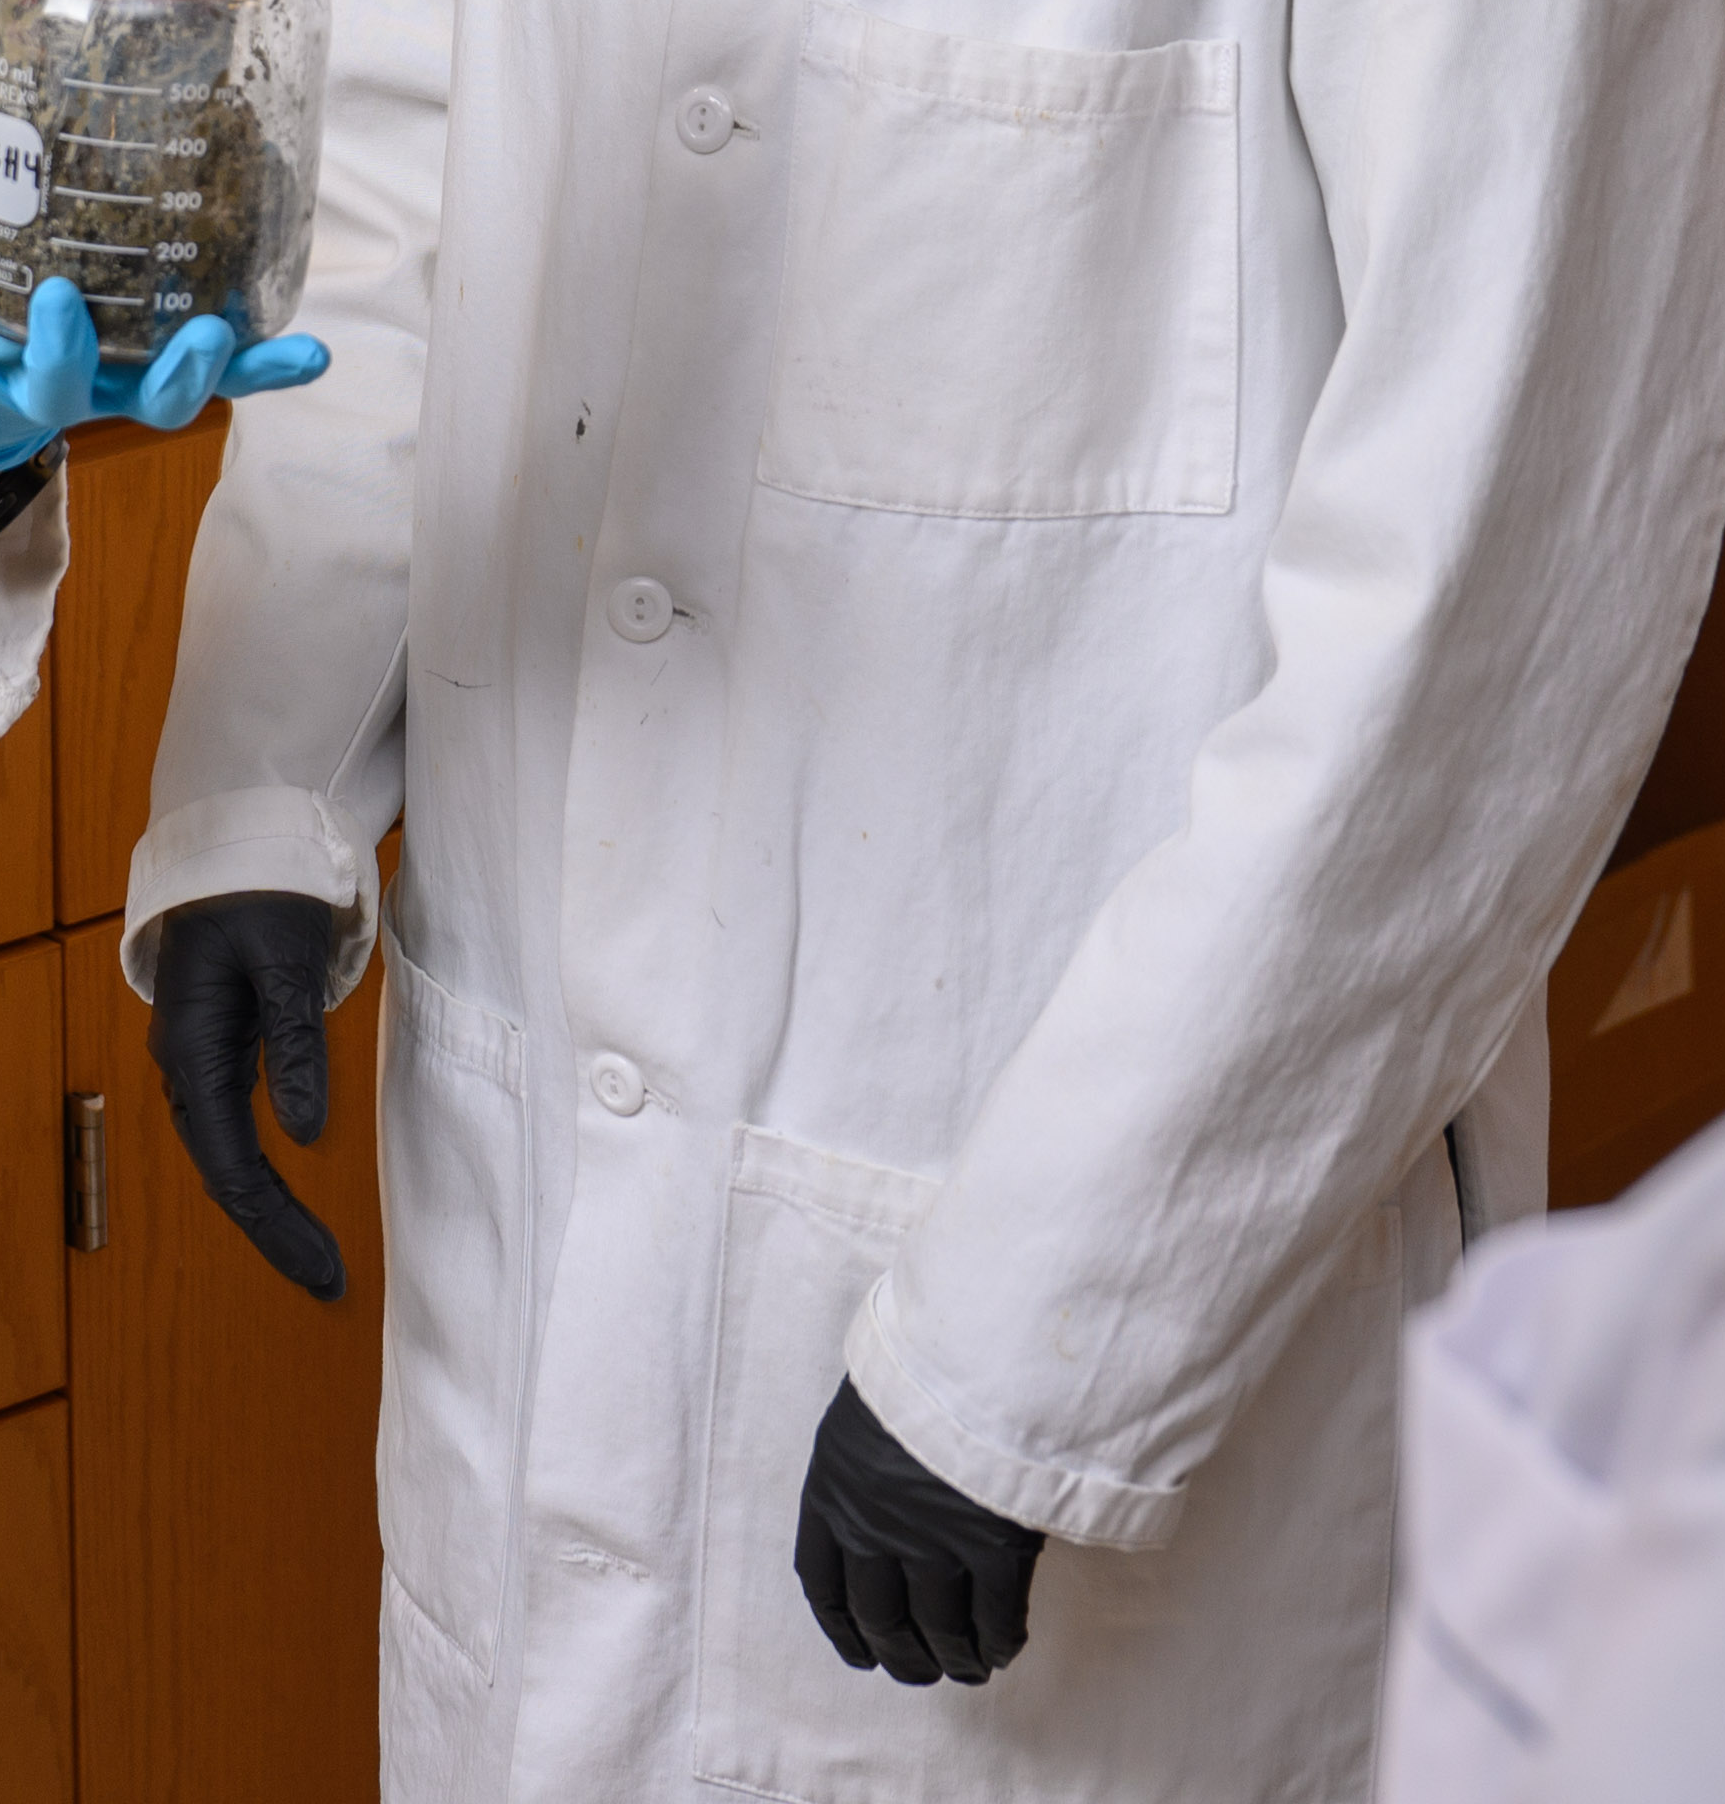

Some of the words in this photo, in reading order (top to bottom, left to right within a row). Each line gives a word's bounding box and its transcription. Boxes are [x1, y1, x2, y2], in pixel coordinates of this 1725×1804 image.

[12, 65, 37, 88] mL
[169, 83, 211, 103] 500
[163, 137, 207, 157] 400
[159, 191, 202, 212] 300
[155, 241, 198, 262] 200
[153, 292, 193, 312] 100
